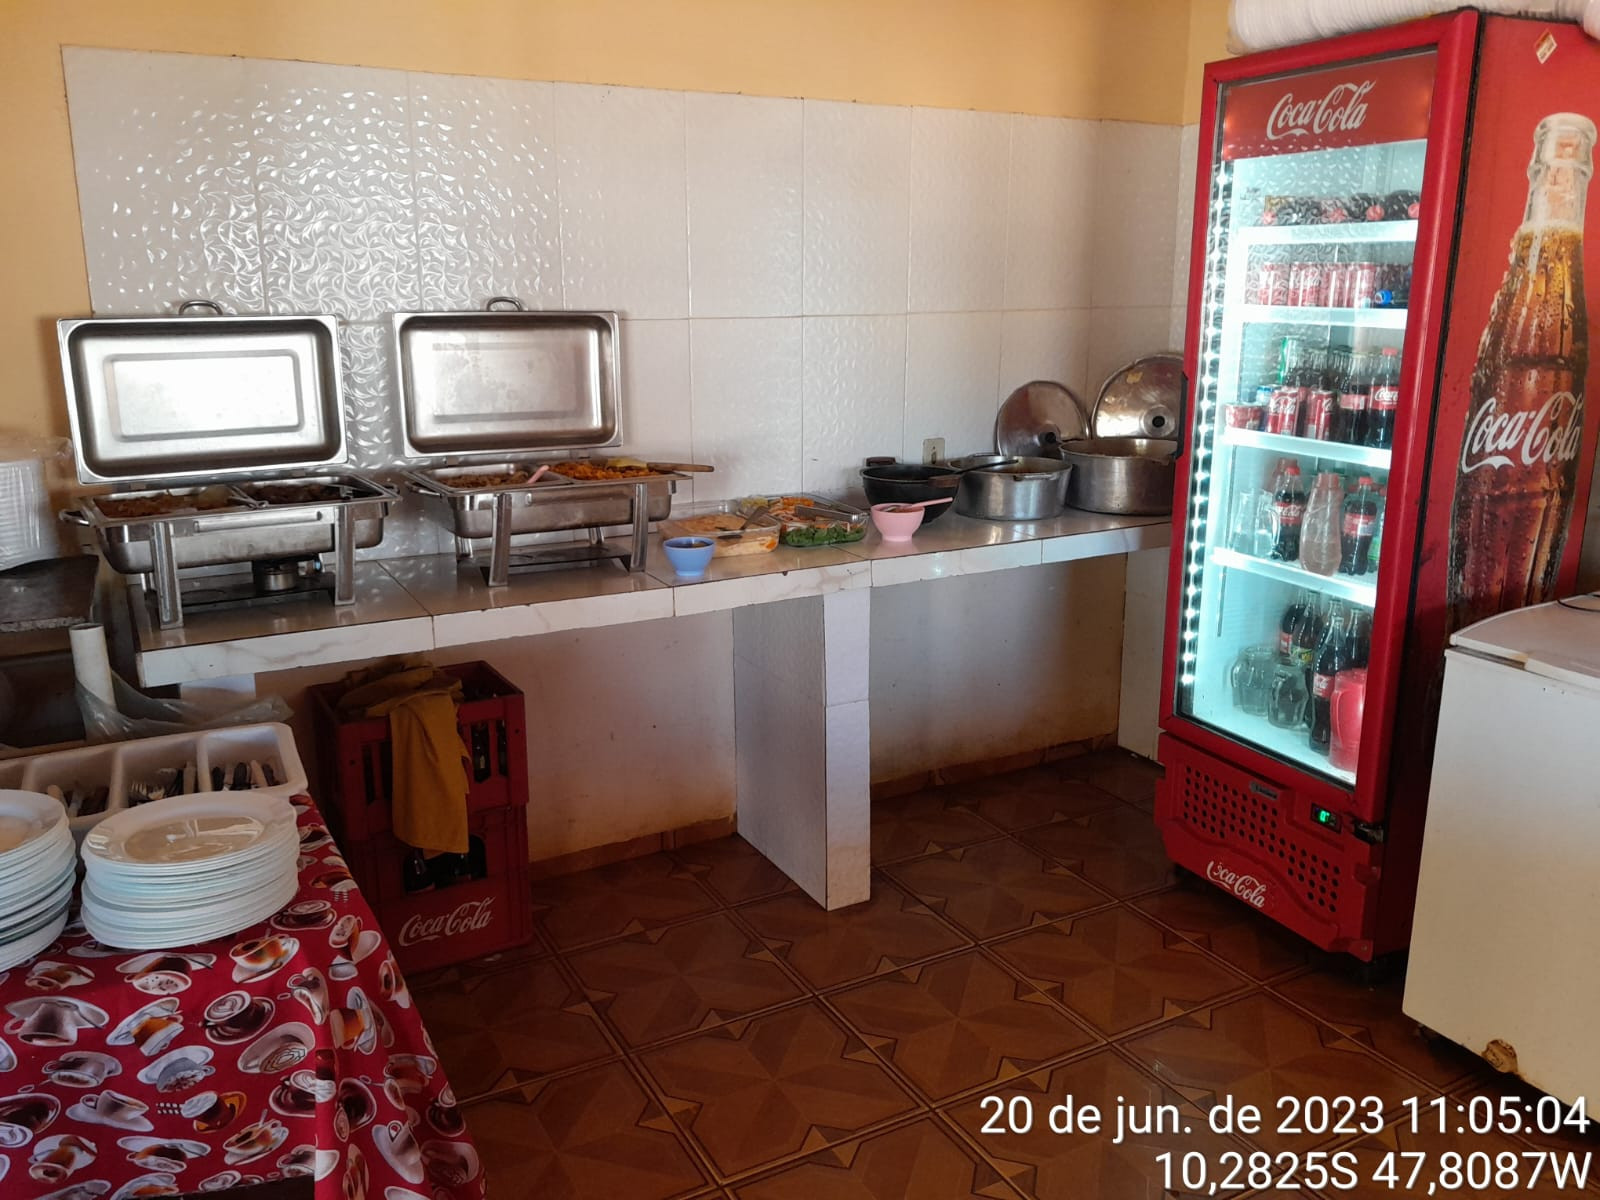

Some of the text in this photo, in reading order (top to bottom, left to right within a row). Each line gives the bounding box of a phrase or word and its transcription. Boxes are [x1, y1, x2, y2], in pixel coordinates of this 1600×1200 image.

[1266, 80, 1376, 140] Coca-Cola
[1461, 391, 1583, 474] Coca-Cola
[398, 896, 496, 947] Coca-Cola
